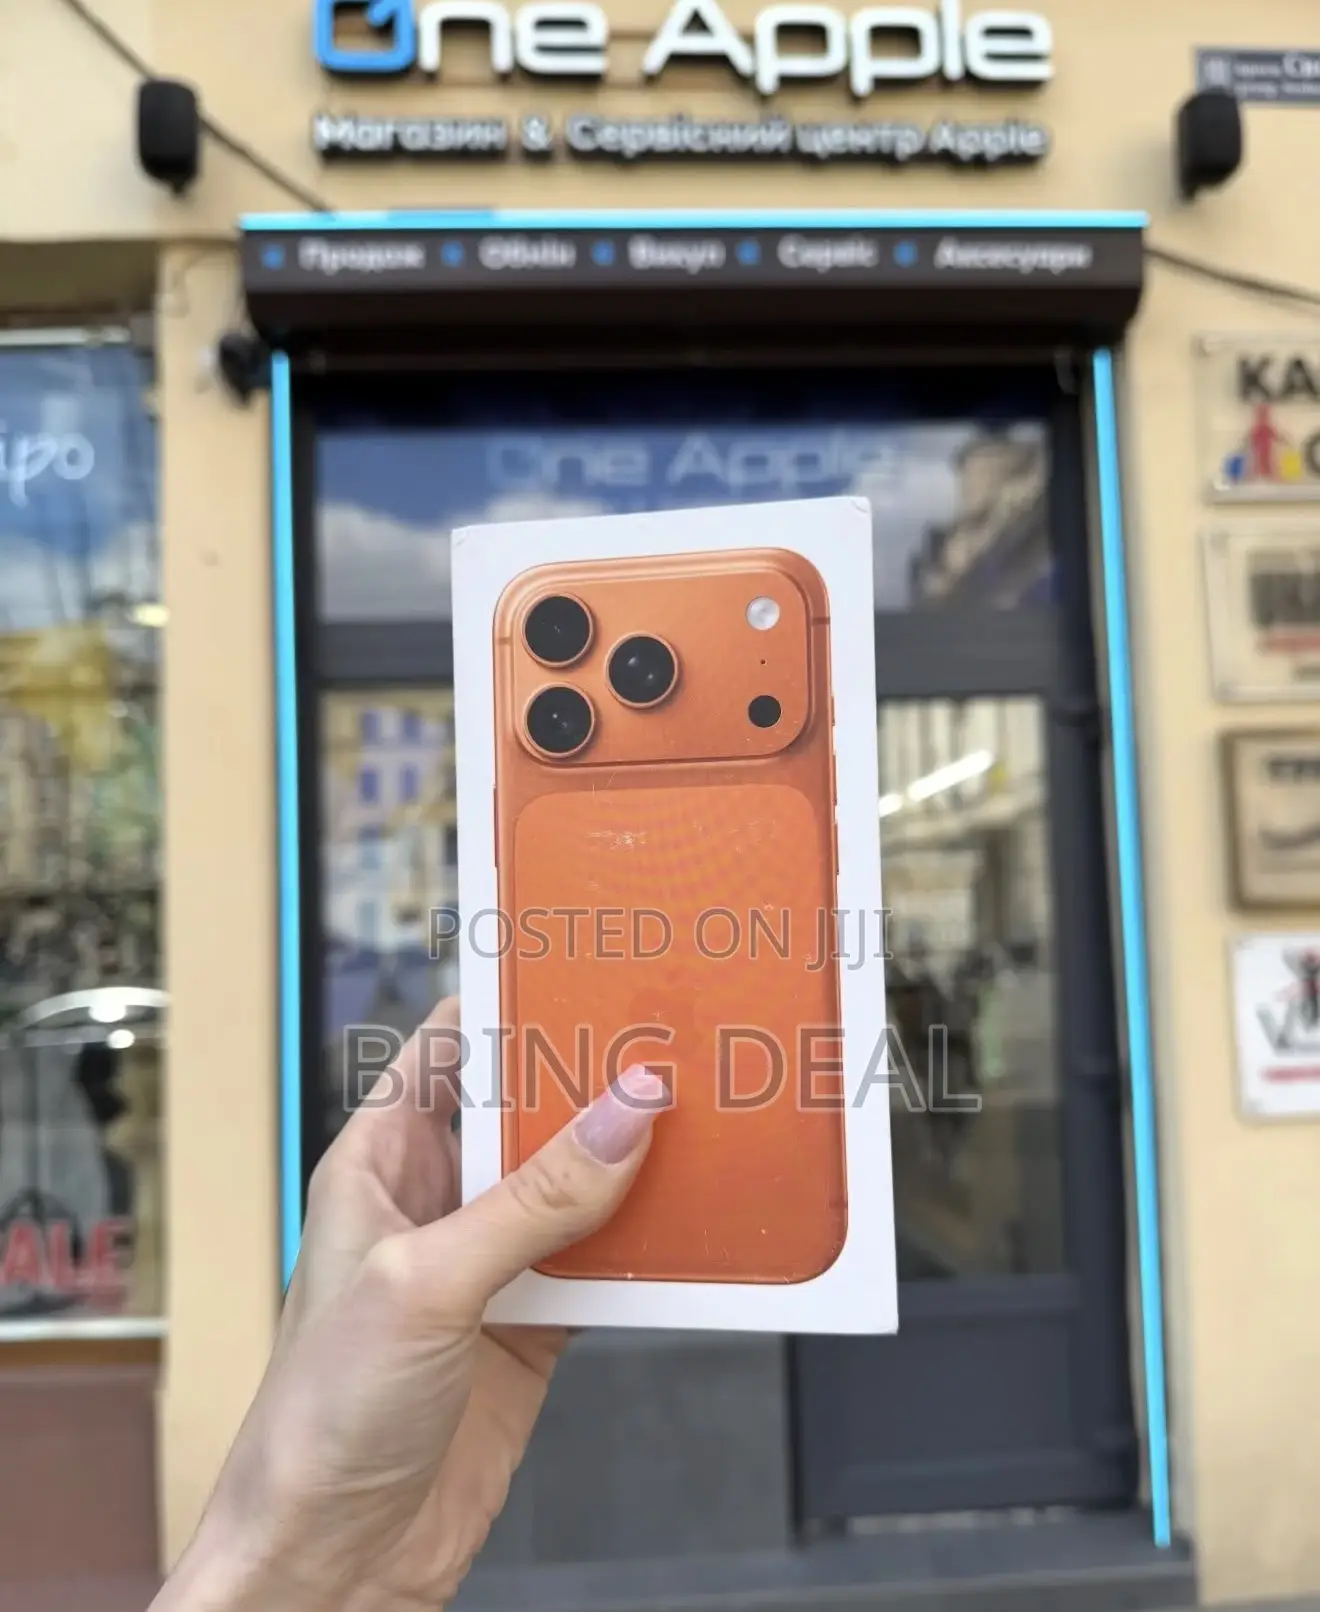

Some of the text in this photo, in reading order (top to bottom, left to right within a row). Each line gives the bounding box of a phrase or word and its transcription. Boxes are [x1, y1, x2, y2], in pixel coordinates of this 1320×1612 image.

[315, 0, 1053, 95] One Apple
[315, 116, 507, 151] Магазин
[522, 116, 551, 150] &
[930, 119, 1051, 161] Apple
[0, 1219, 134, 1290] ALE
